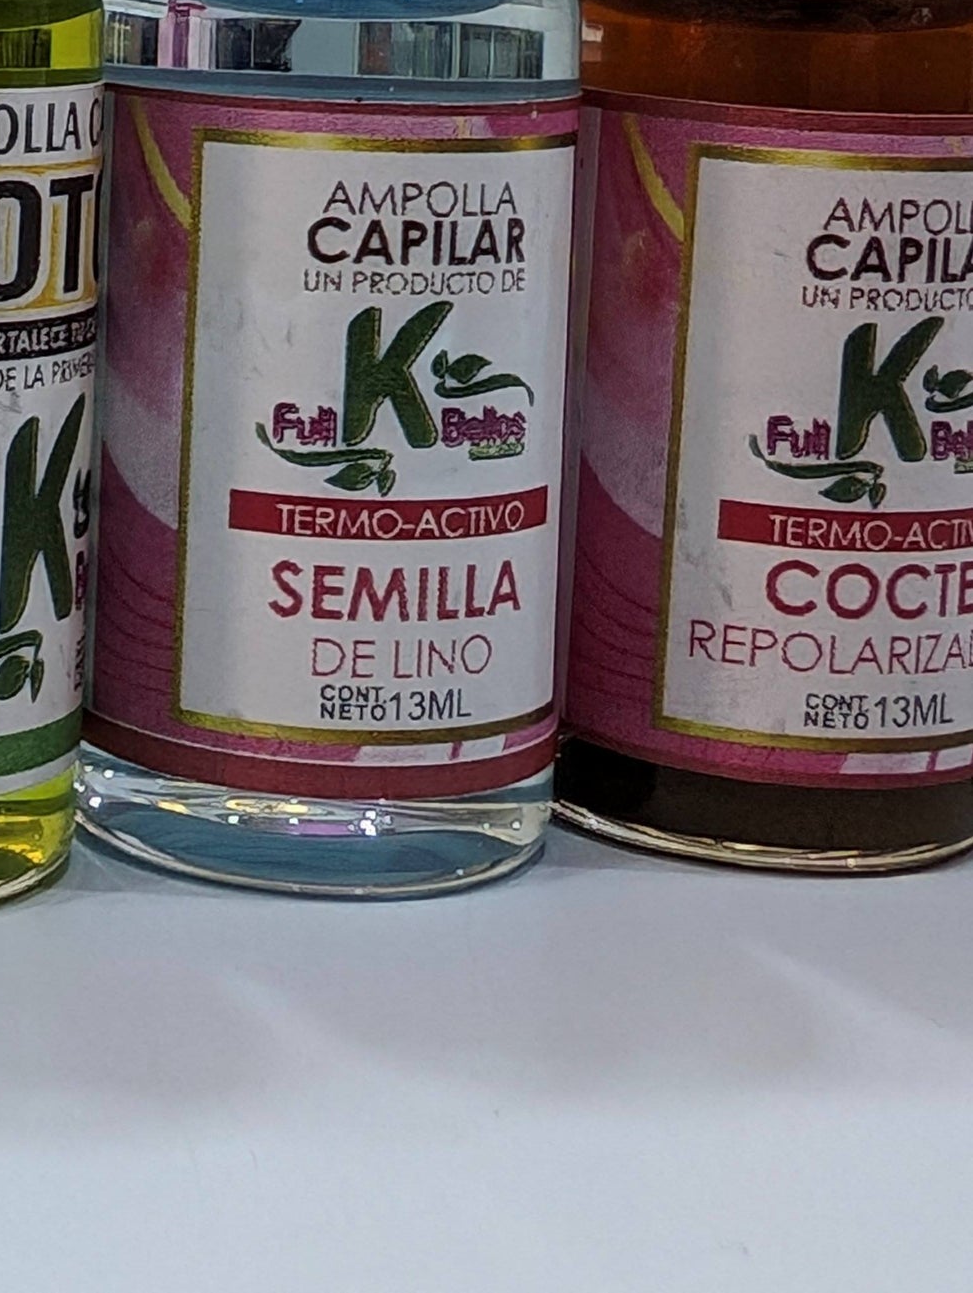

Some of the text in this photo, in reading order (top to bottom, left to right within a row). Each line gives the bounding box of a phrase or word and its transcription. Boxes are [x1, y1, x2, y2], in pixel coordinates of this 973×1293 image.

[323, 180, 518, 218] AMPOLLA
[823, 196, 973, 236] AMPOL
[307, 216, 526, 266] CAPILAR
[303, 267, 527, 296] UN PRODUCTO DE
[801, 285, 841, 310] UN
[23, 364, 45, 390] LA
[341, 300, 454, 448] K
[835, 316, 945, 462] K
[276, 500, 525, 540] TERMO-ACTIVO
[268, 559, 522, 622] SEMILLA
[311, 634, 493, 679] DE LINO
[688, 619, 973, 676] REPOLARIZA
[319, 703, 386, 722] NETO
[388, 688, 473, 722] 13ML
[803, 712, 870, 730] NETO
[874, 692, 954, 729] 13ML
